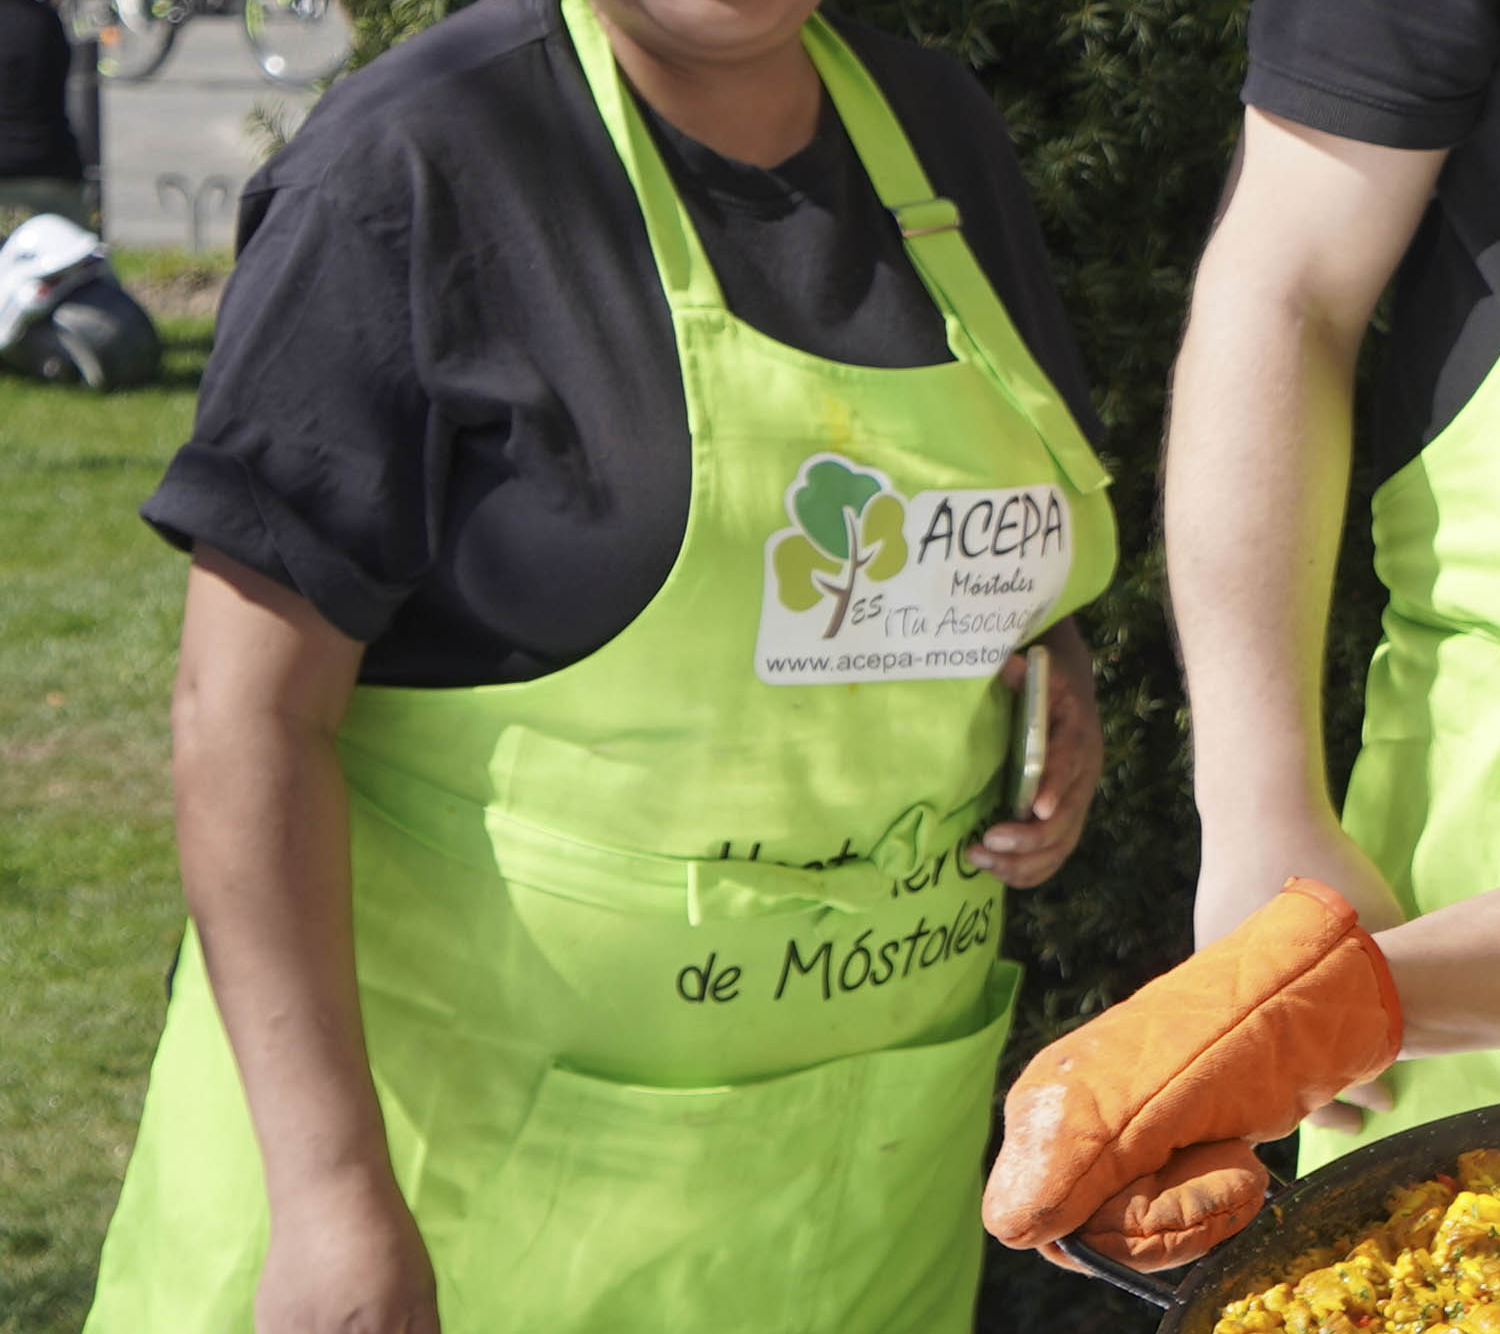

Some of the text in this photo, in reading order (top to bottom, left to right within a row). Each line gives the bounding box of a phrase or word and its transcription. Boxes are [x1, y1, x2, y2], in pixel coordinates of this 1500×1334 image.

[917, 492, 1064, 564] ACEPA
[850, 595, 883, 625] ES
[677, 897, 994, 1002] de Móstoles
